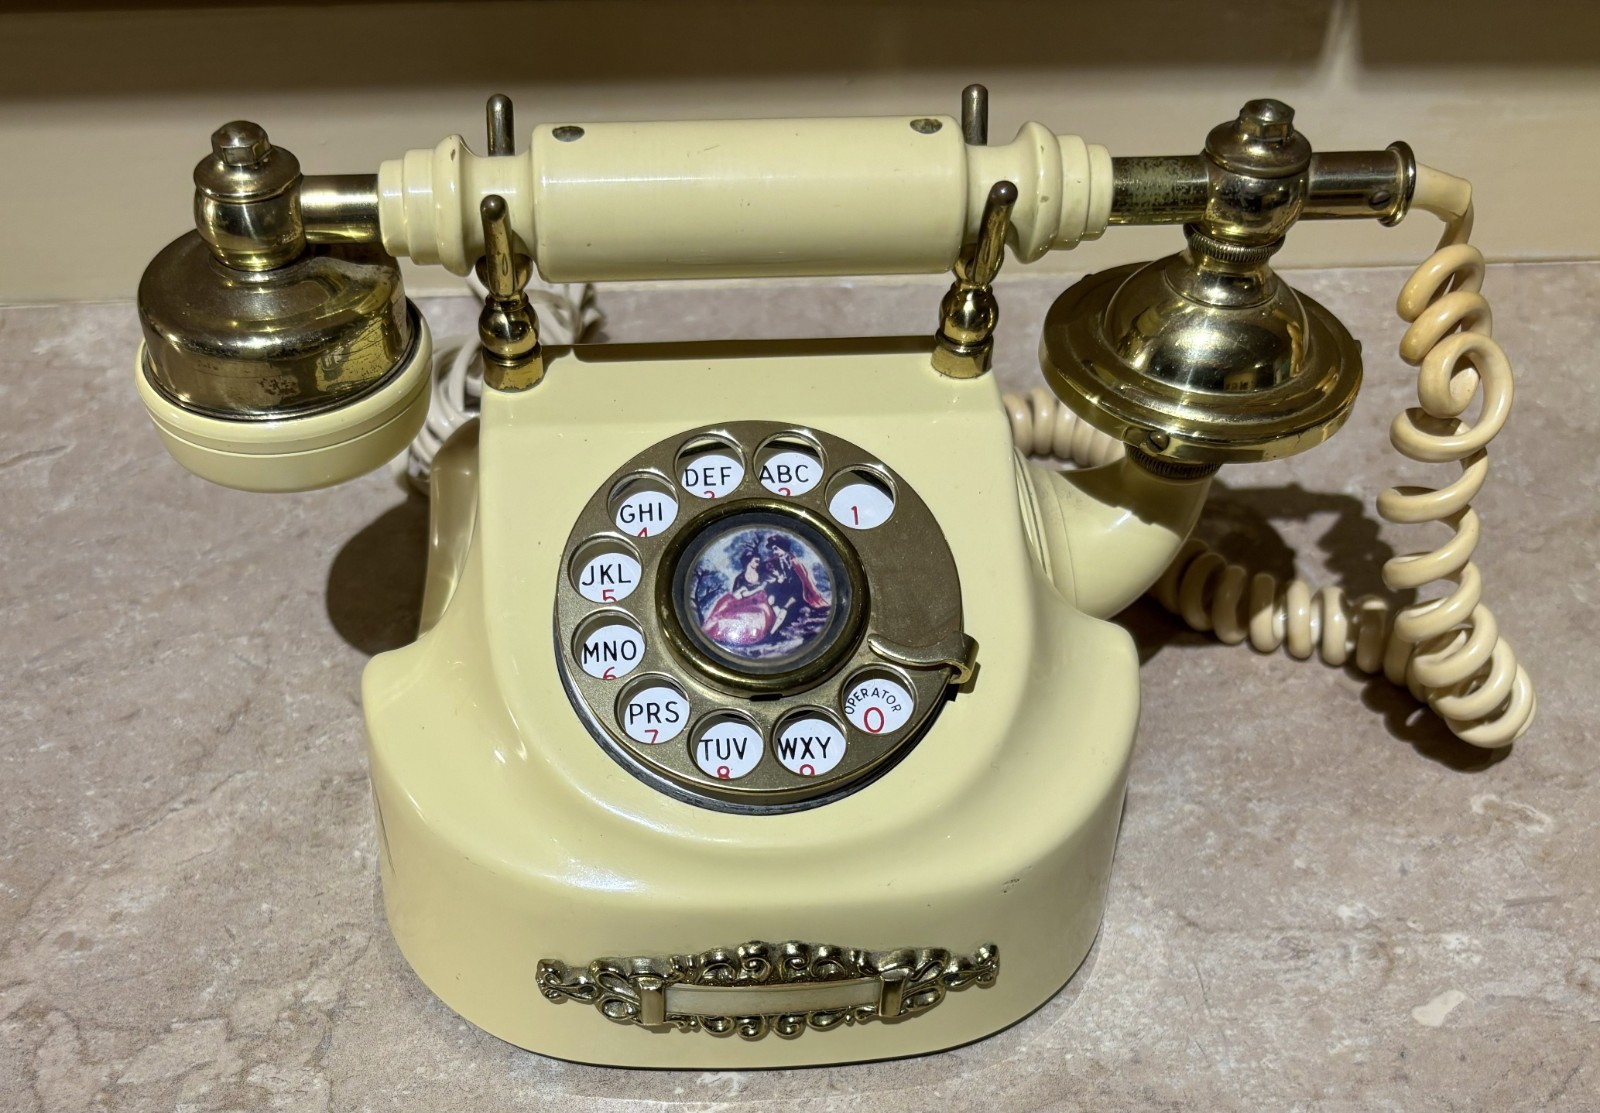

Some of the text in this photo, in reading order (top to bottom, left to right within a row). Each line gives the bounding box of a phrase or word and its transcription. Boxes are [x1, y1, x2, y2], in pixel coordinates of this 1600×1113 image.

[684, 466, 732, 487] DEF
[759, 464, 809, 483] ABC
[620, 502, 663, 524] GHI
[850, 505, 859, 525] 1
[581, 563, 632, 586] JKL
[602, 588, 617, 602] 5
[583, 639, 637, 664] MNO
[844, 687, 902, 715] OPERATOR
[629, 701, 680, 725] PRS
[644, 728, 659, 745] 7
[699, 737, 748, 761] TUV
[777, 736, 831, 760] WXY
